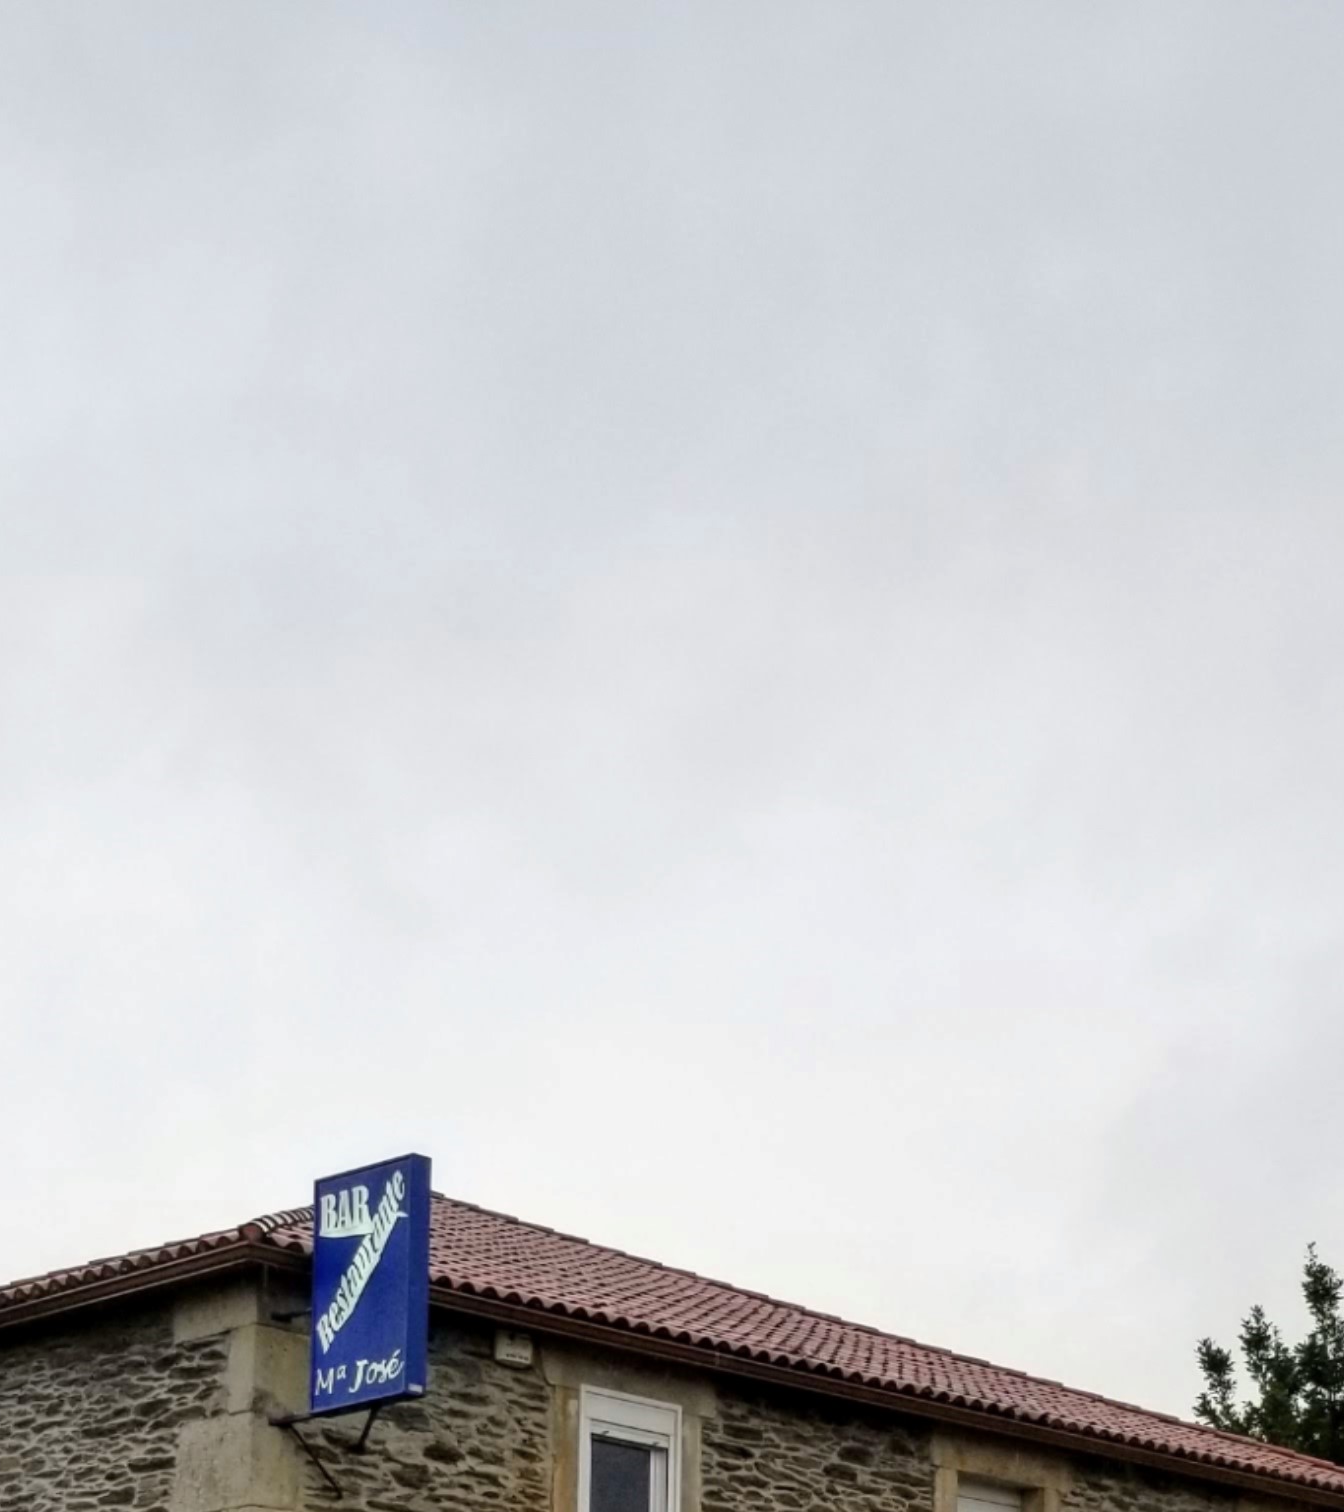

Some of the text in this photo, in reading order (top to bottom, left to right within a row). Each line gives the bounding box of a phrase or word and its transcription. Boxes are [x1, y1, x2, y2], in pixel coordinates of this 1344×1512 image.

[320, 1185, 371, 1232] BAR
[316, 1169, 406, 1354] Restaurante
[348, 1349, 406, 1393] José
